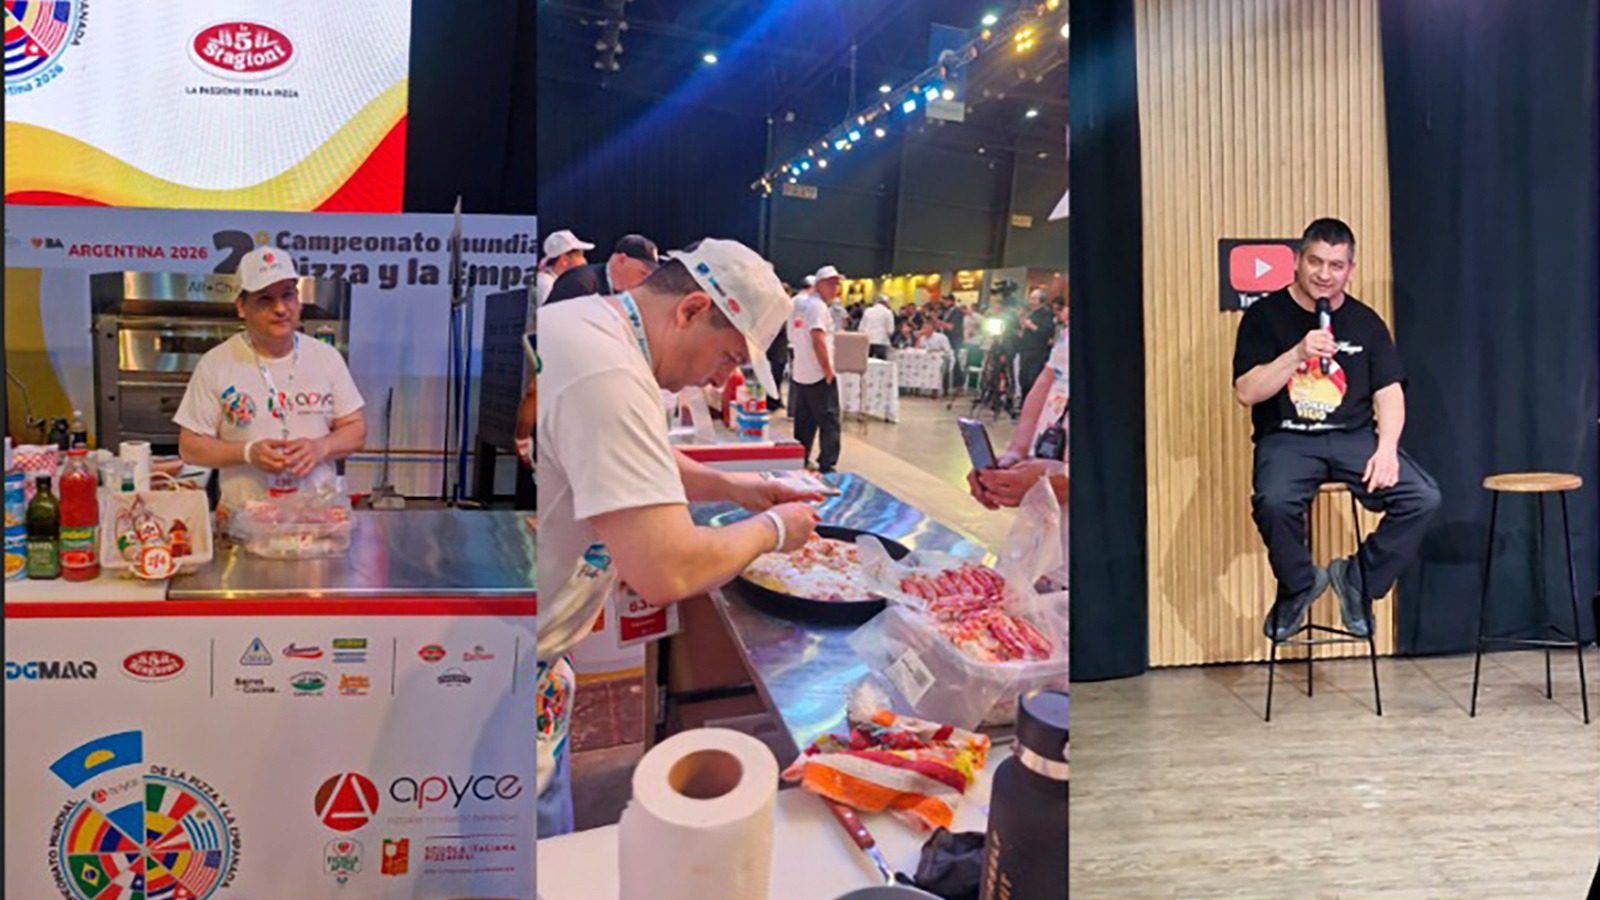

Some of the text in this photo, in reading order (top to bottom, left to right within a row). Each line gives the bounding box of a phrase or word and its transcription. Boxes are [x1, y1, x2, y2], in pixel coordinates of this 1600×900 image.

[70, 0, 89, 46] ANADA
[203, 40, 286, 71] Stagioni
[234, 31, 253, 52] 5
[35, 64, 64, 87] 2026
[68, 244, 208, 259] ARGENTINA 2026
[276, 230, 441, 255] Campeonato
[292, 257, 369, 284] izza
[378, 264, 399, 290] y
[407, 258, 440, 284] la
[389, 773, 523, 809] apyce
[49, 799, 77, 848] MUNDIAL
[149, 765, 242, 888] DE LA PIZZA Y LA EMPANADA
